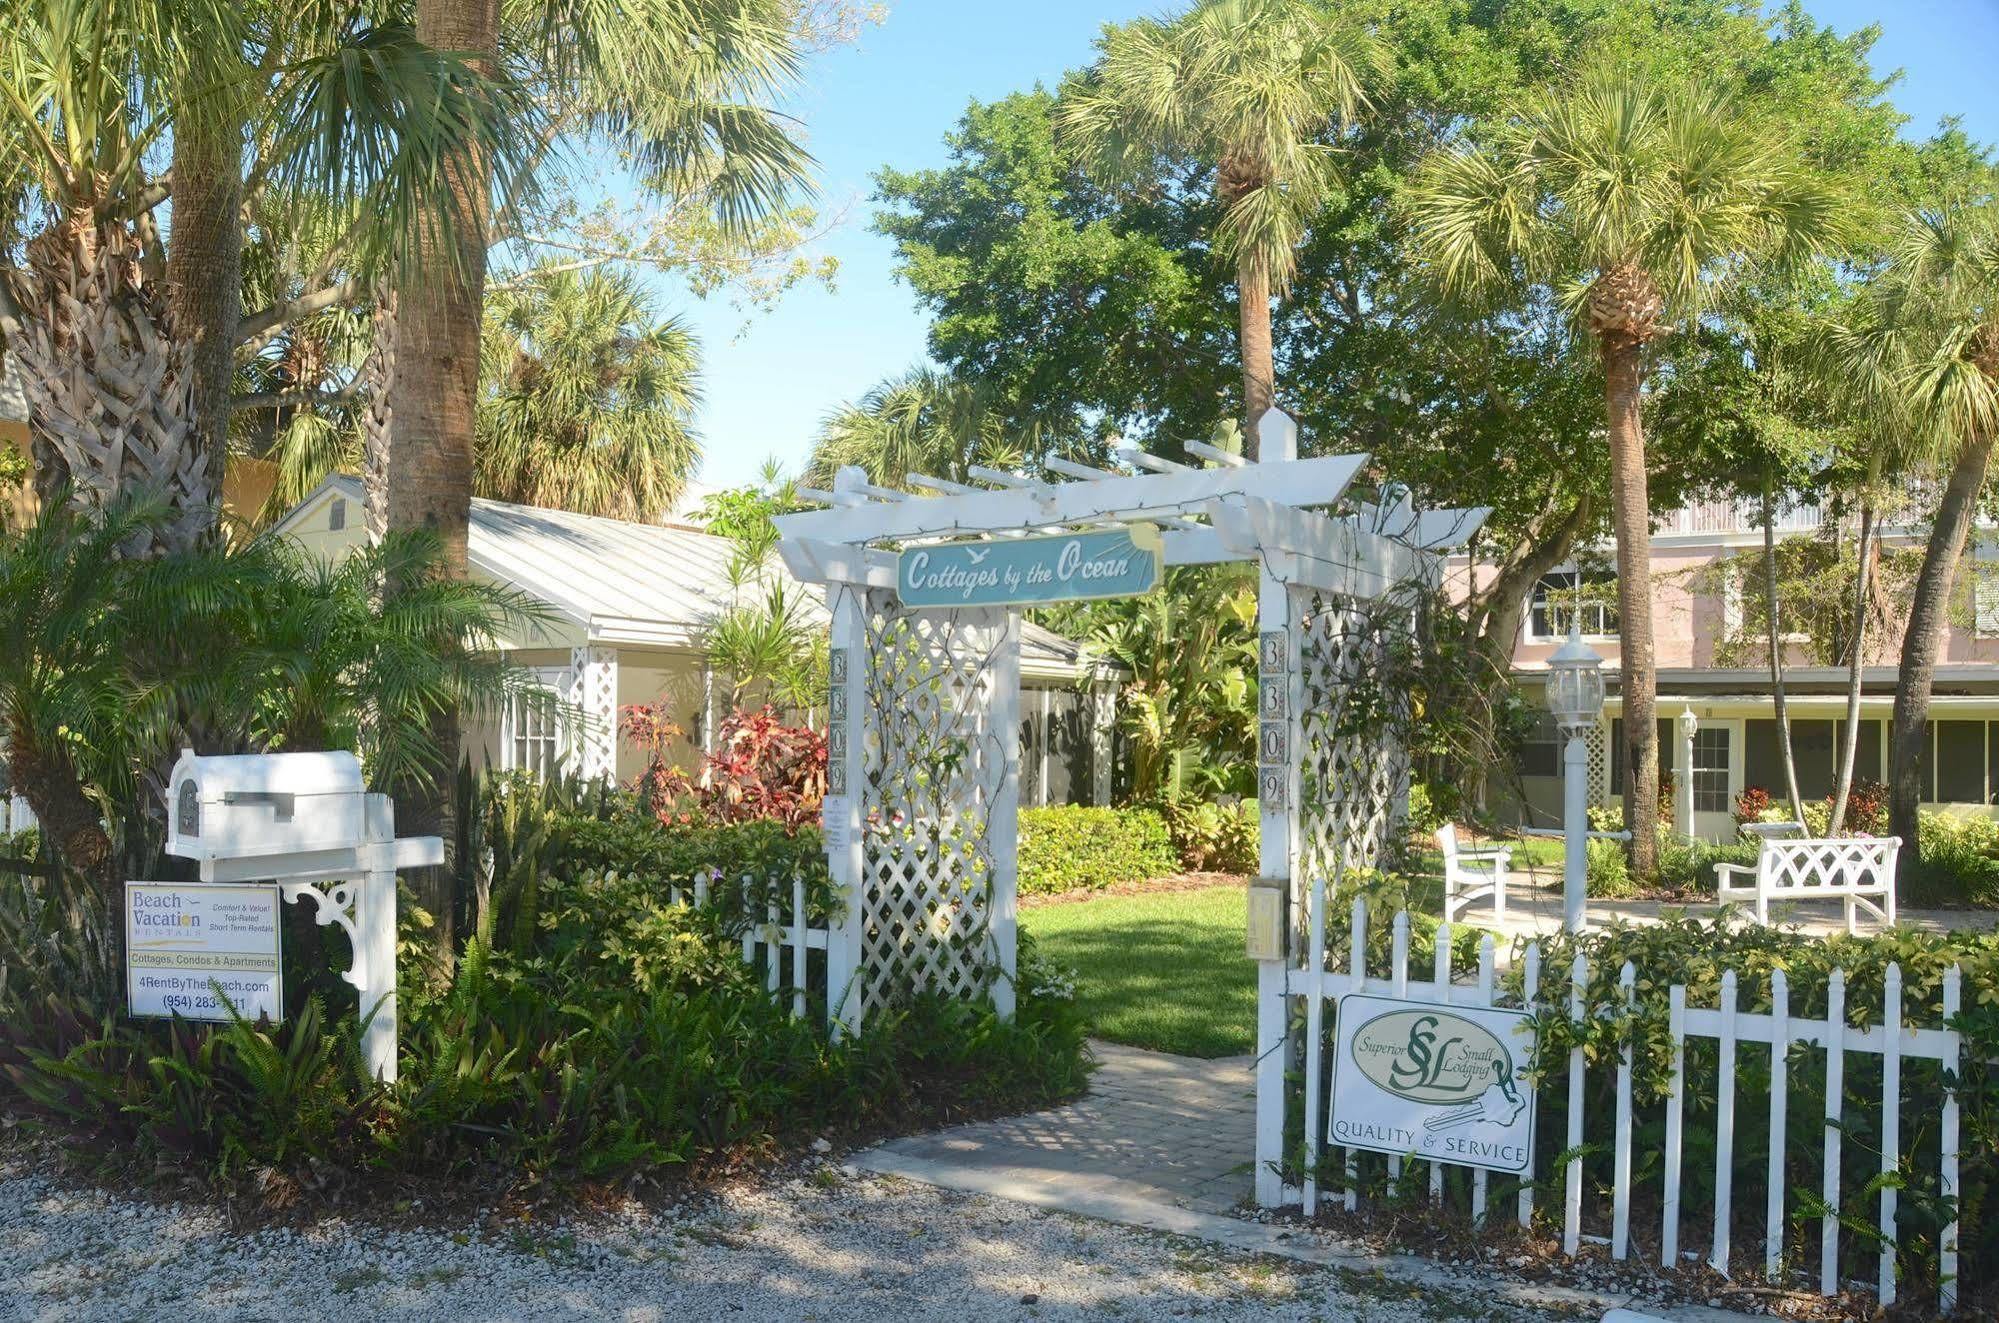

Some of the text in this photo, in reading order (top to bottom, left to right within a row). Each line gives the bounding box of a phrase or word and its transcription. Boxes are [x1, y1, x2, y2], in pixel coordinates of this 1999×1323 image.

[908, 540, 1128, 598] Cottages by the Ocean
[833, 655, 843, 785] 3309
[1266, 640, 1279, 799] 3309
[133, 891, 181, 908] Beach
[212, 904, 241, 912] Comfort
[133, 910, 201, 927] Vacation
[225, 914, 260, 922] Top-Rated
[209, 923, 229, 931] Short
[248, 925, 274, 933] Rentals
[131, 953, 275, 967] Cottages, Condos & Apartments
[139, 976, 269, 992] 4RentByTheBach.com
[163, 995, 245, 1010] (954) 283-11
[1358, 1037, 1407, 1057] Superior
[1457, 1044, 1495, 1062] Small
[1440, 1058, 1490, 1080] Lodging
[1335, 1120, 1525, 1162] QUALITY & SERVICE
